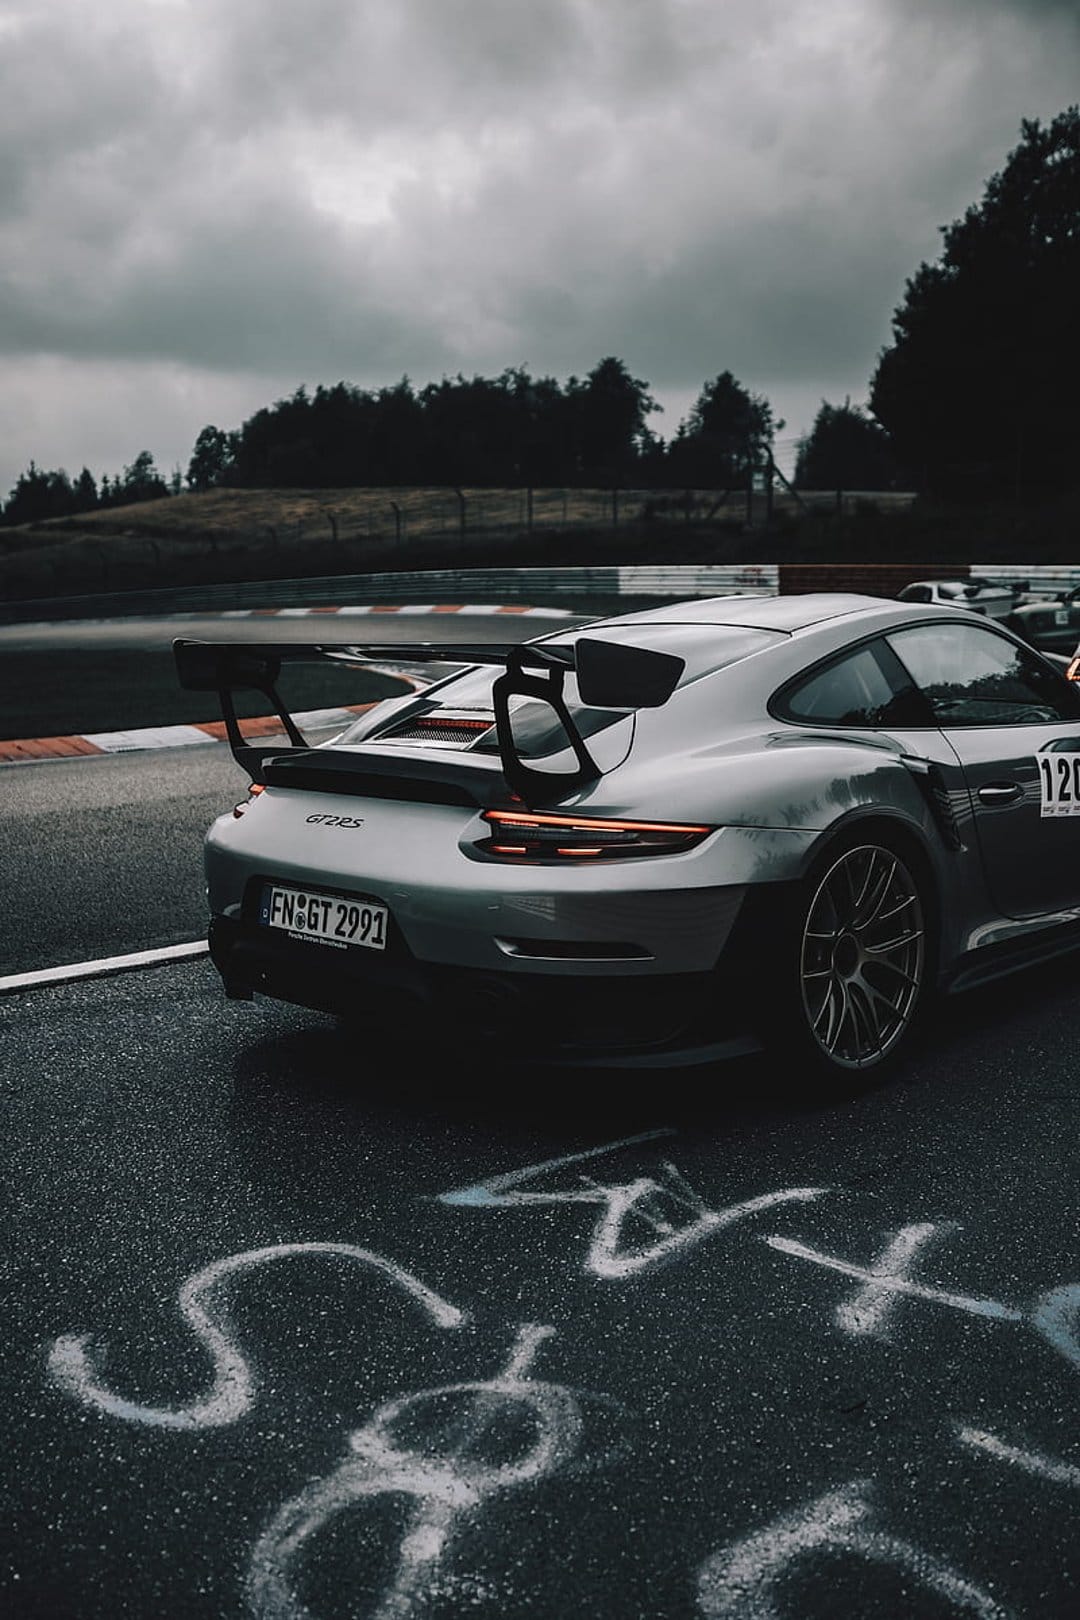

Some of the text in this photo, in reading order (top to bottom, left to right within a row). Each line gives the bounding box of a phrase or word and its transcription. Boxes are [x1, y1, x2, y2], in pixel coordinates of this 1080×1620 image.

[271, 893, 295, 926] FN
[307, 899, 332, 933] GT
[335, 905, 384, 944] 2991
